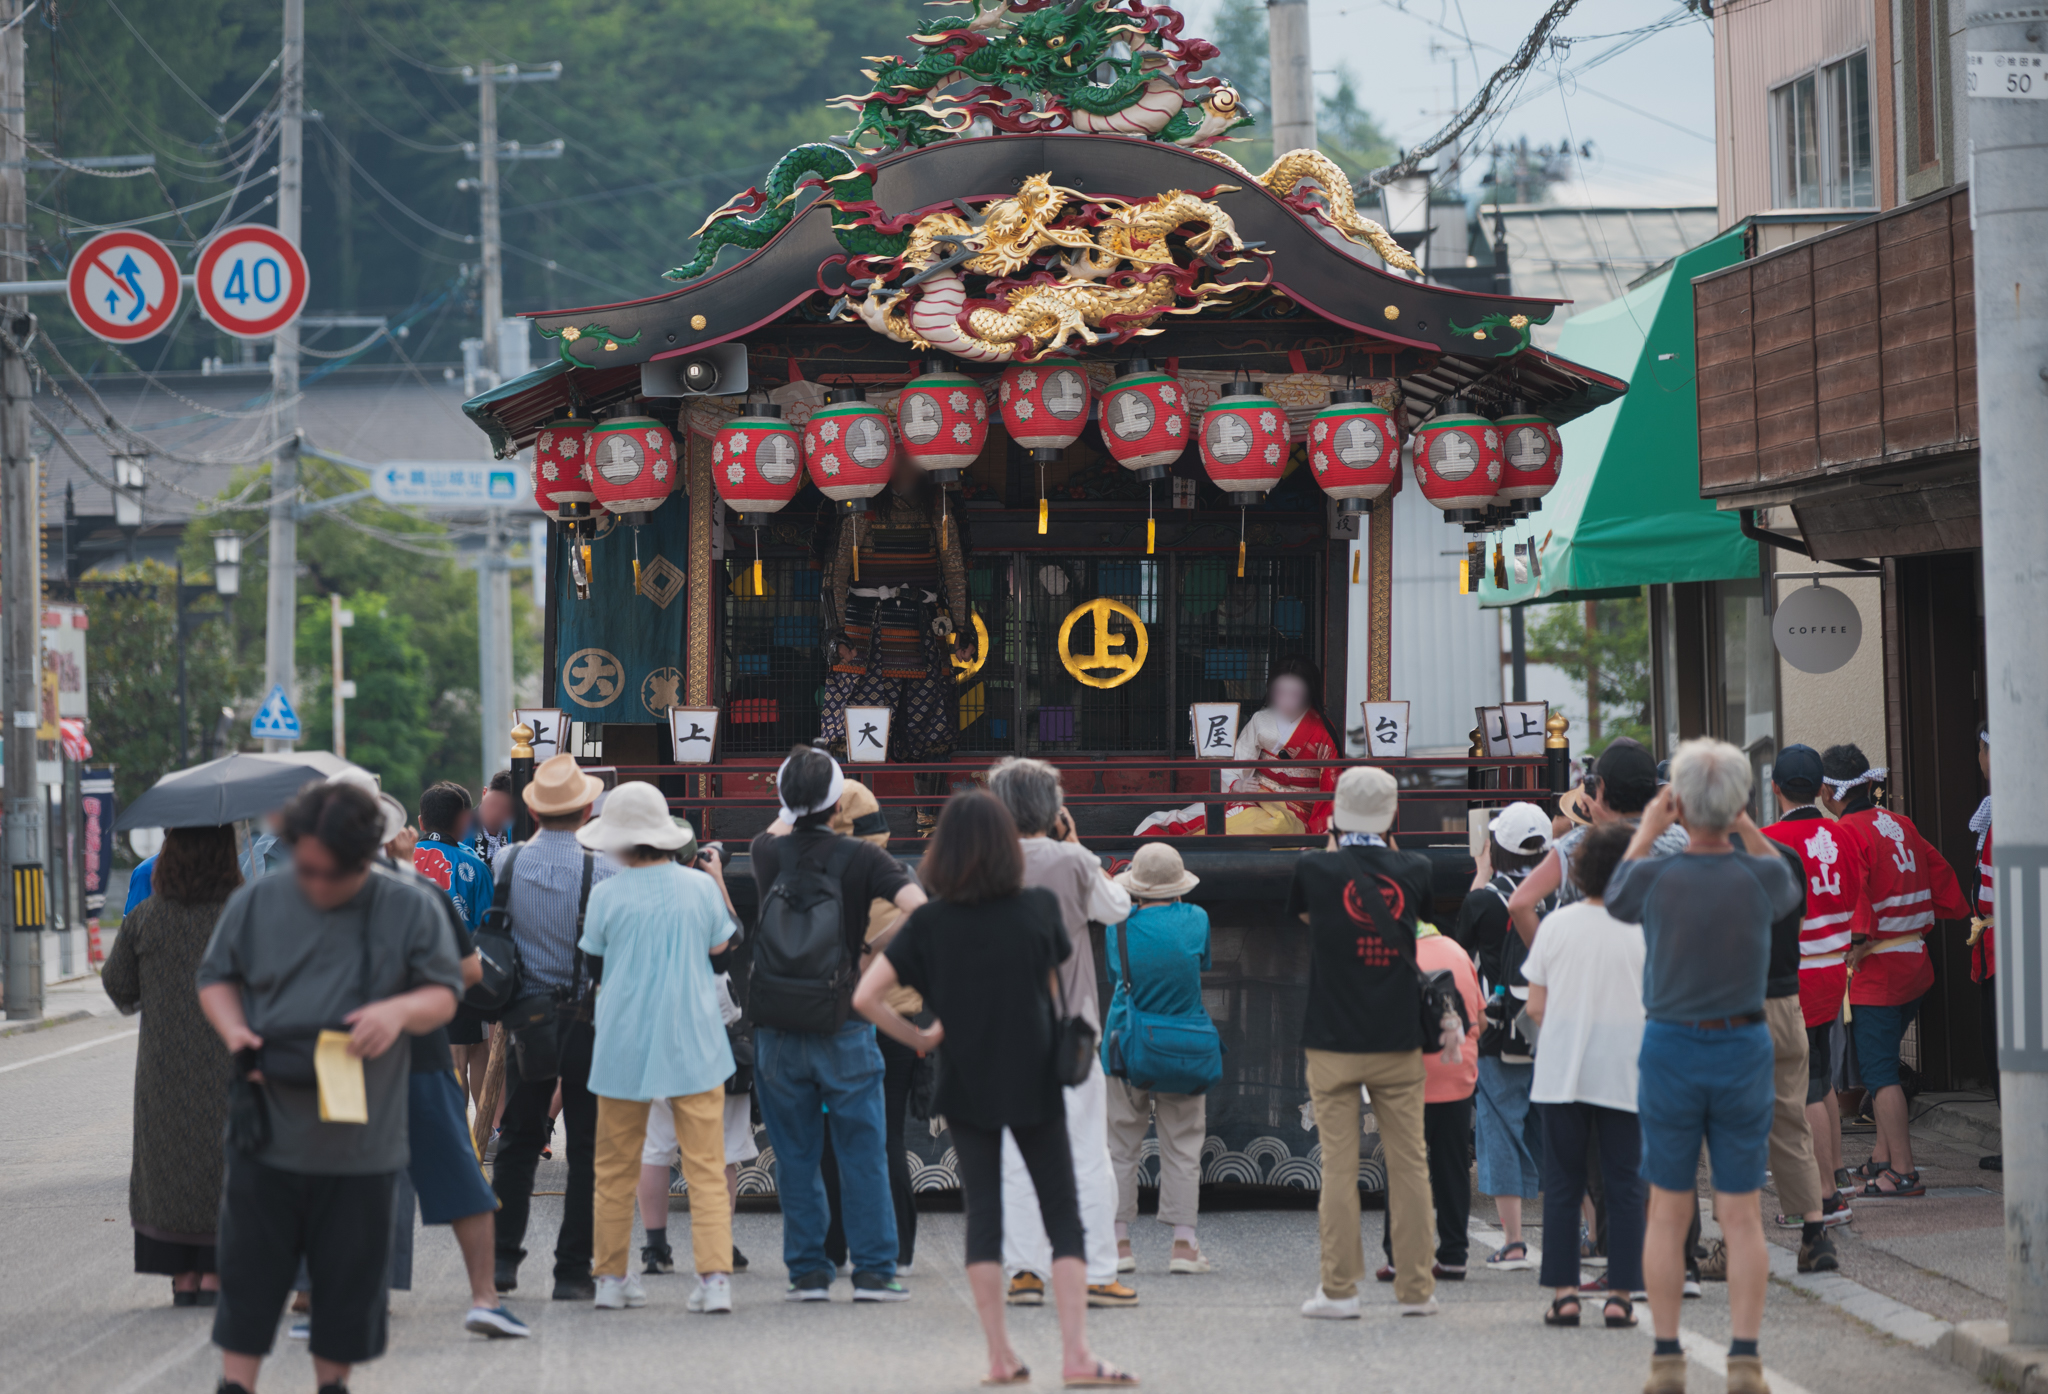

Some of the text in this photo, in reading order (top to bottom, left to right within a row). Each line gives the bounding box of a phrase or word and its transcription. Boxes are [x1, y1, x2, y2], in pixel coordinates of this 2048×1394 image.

[2007, 73, 2031, 93] 50
[224, 258, 281, 304] 40
[1049, 370, 1083, 416] 上
[1113, 391, 1151, 438] 上
[904, 394, 940, 440] 上
[1211, 415, 1250, 459] 上
[600, 435, 639, 479] 上
[761, 435, 796, 479] 上
[852, 417, 888, 463] 上
[1340, 419, 1381, 465] 上
[1435, 431, 1476, 475] 上
[1510, 427, 1547, 468] 上
[1070, 600, 1134, 669] 上
[1789, 626, 1847, 635] COFFEE
[571, 654, 617, 697] 大
[528, 719, 556, 746] 上
[678, 723, 711, 742] 上
[857, 722, 884, 748] 大
[1204, 715, 1233, 749] 屋
[1375, 716, 1399, 744] 台
[1513, 712, 1544, 739] 上
